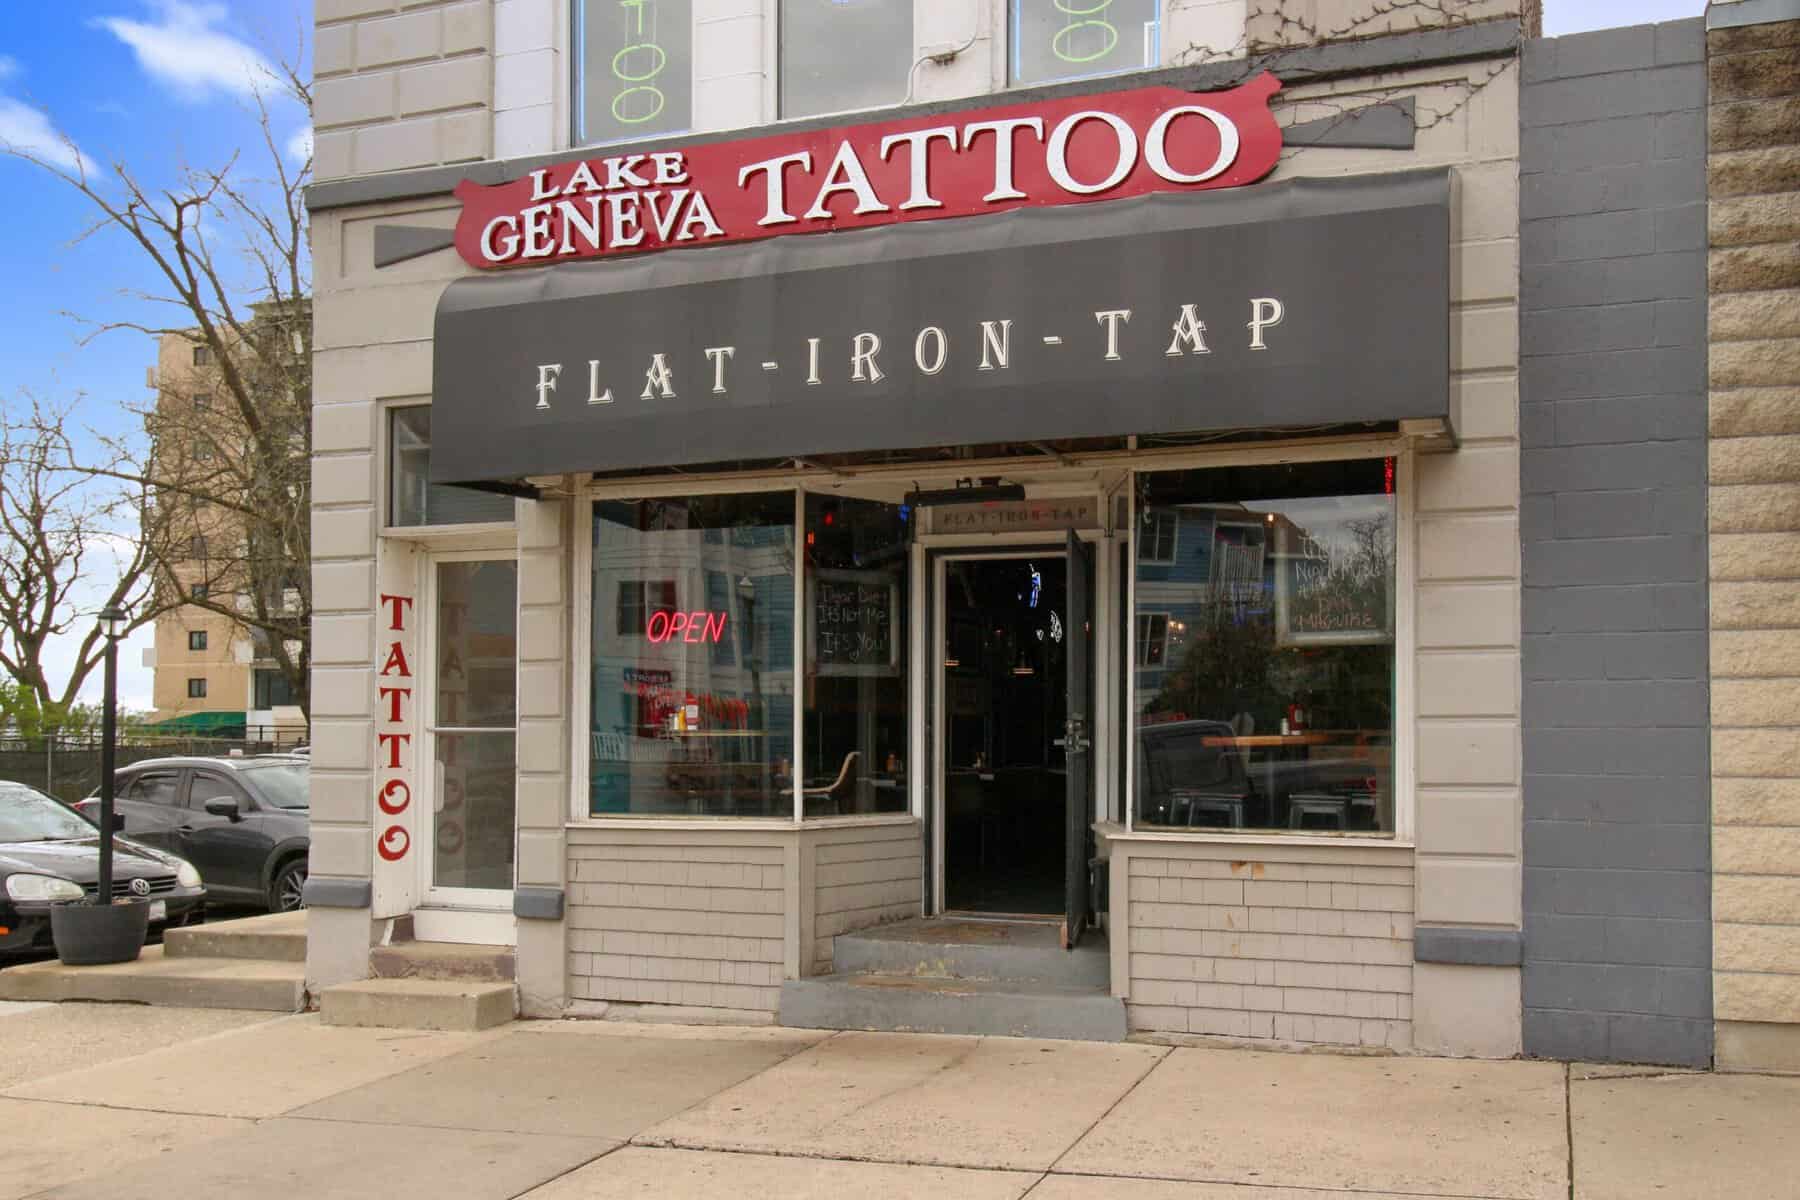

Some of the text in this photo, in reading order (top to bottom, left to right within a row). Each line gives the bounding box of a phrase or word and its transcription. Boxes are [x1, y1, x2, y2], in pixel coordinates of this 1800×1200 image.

[529, 151, 688, 201] LAKE
[738, 105, 1239, 226] TATTOO
[480, 189, 724, 261] GENEVA
[647, 611, 727, 643] OPEN
[378, 594, 413, 861] TATTOO
